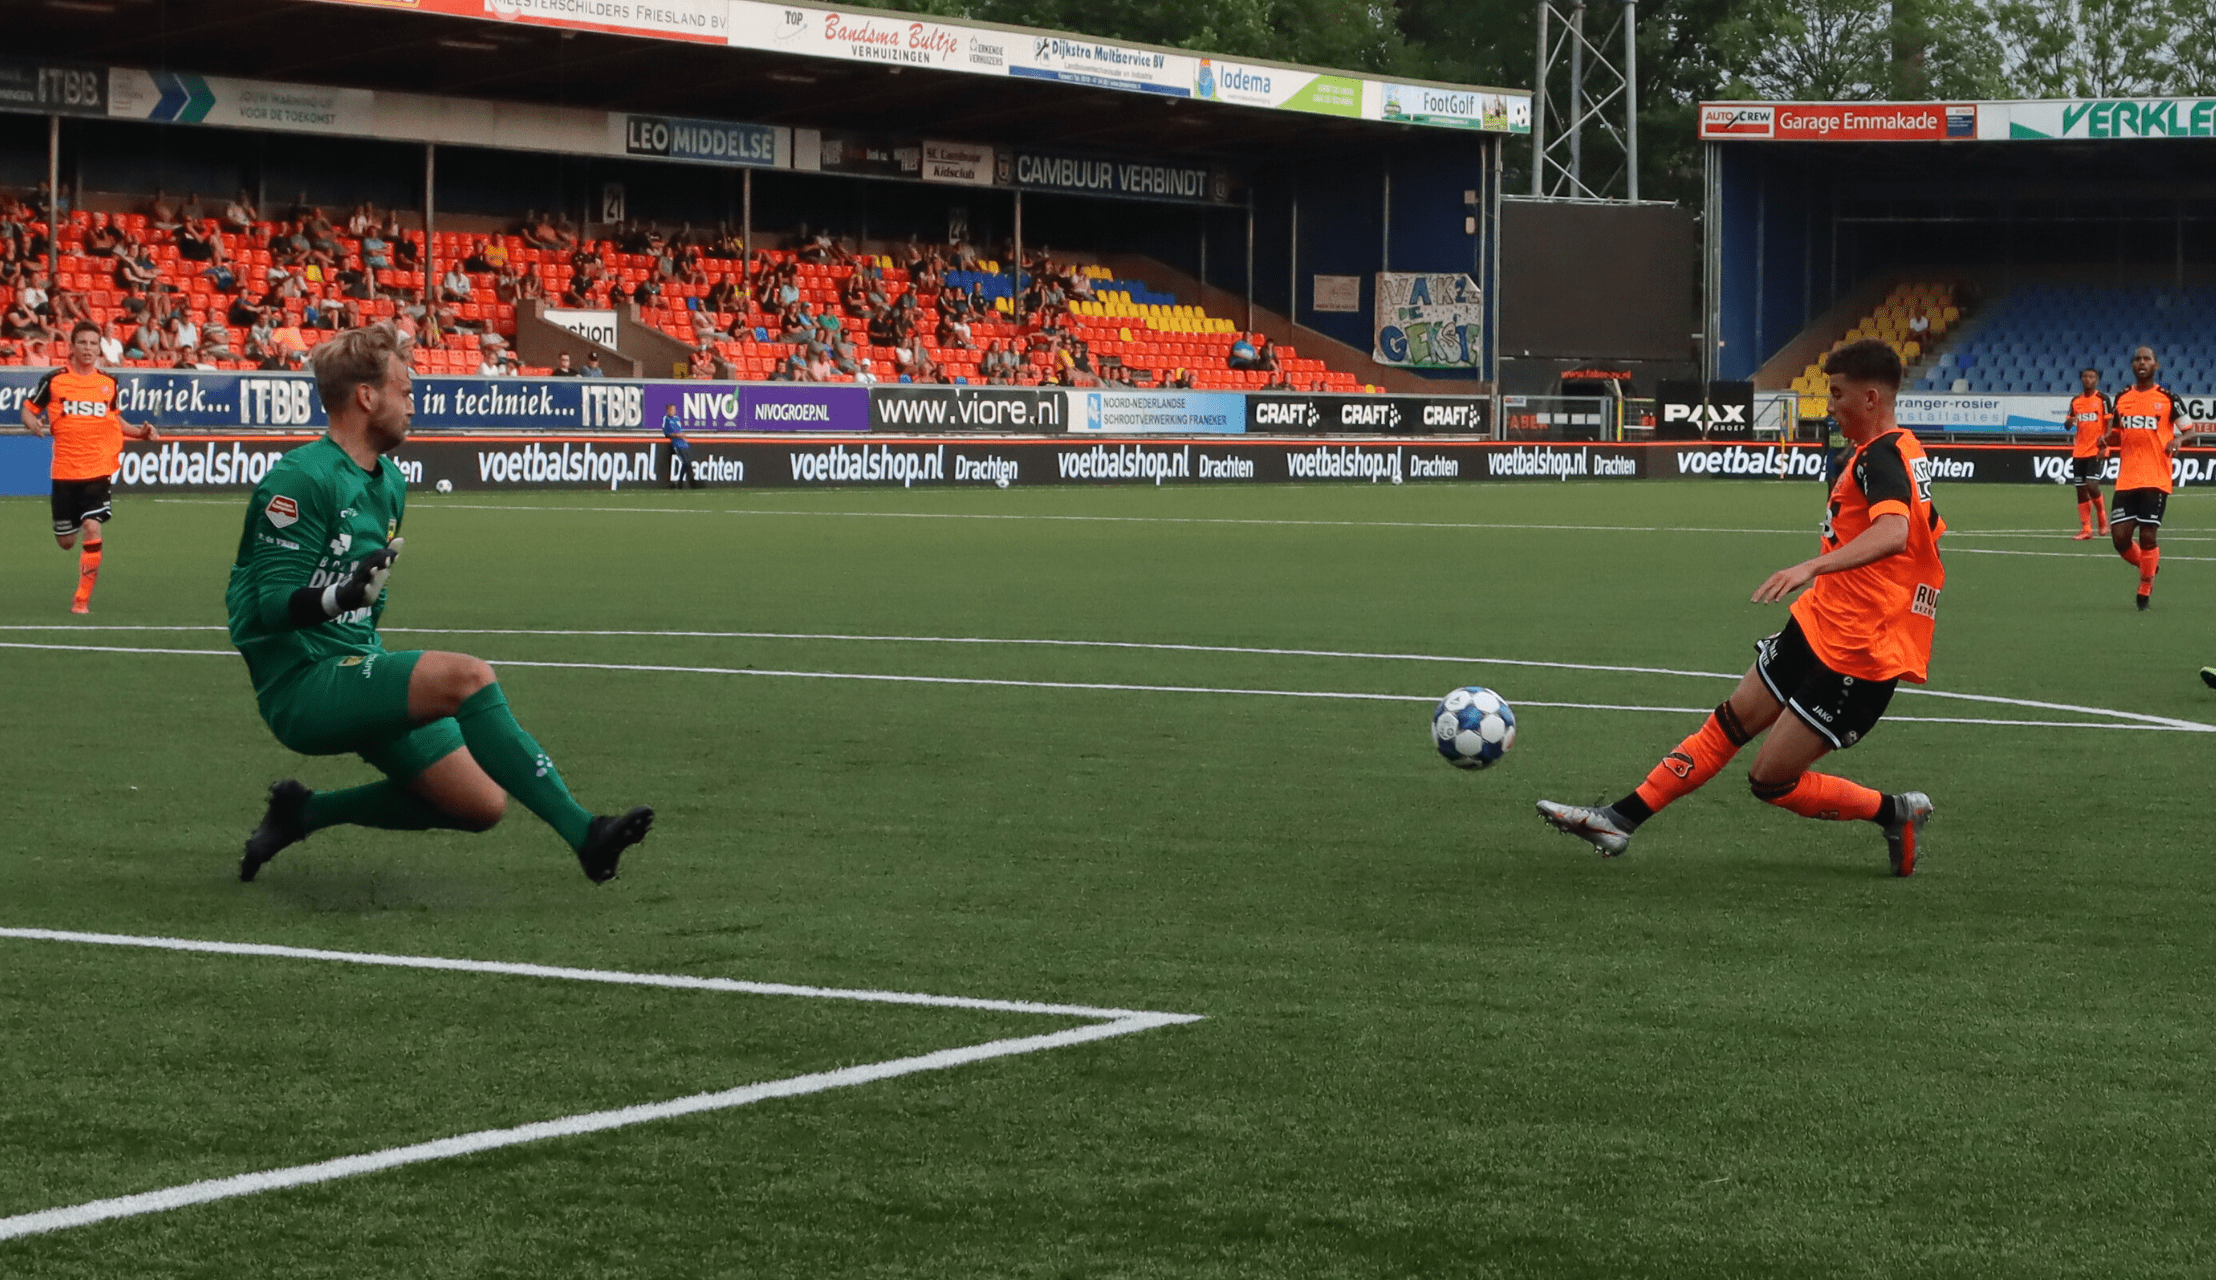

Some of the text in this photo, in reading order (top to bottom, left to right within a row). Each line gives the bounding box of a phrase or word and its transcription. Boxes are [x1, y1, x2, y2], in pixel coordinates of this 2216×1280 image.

[636, 5, 706, 27] FRIESLAND
[711, 15, 727, 29] BV
[784, 10, 804, 26] TOP
[824, 12, 958, 62] Bandsma Bultje
[851, 44, 931, 63] VERHUIZINGEN
[1052, 39, 1165, 69] Dijkstra Multiservice BV
[1423, 92, 1475, 115] FootGolf
[1706, 111, 1771, 121] AUTO CREW
[1779, 111, 1840, 134] Garage
[1843, 111, 1938, 130] Emmakade
[2063, 101, 2216, 137] VERKLE
[628, 121, 774, 160] LEO MIDDELSE
[933, 165, 975, 179] Kidsclub
[1017, 155, 1207, 197] CAMBUUR VERBINDT
[118, 377, 230, 413] chniek...
[240, 378, 312, 425] ITBB
[423, 384, 642, 427] in techniek... ITBB
[683, 392, 739, 420] NIVO
[1103, 397, 1186, 409] NOORD-NEDERLANDSE
[1895, 399, 2000, 411] ranger-rosier
[63, 400, 108, 417] HSB
[755, 403, 830, 421] NIVOGROEP.NL
[877, 391, 1060, 425] www.viore.nl
[1256, 402, 1306, 425] CRAFT
[1341, 403, 1387, 425] CRAFT
[1423, 405, 1468, 426] CRAFT
[1664, 403, 1746, 423] PAX
[1895, 410, 2000, 422] nstallaties
[2076, 412, 2098, 422] HSB
[1103, 414, 1227, 426] SCHROOTVERWERKING FRANEKER
[2120, 415, 2158, 430] HSB
[478, 441, 744, 491] voetbalshop.nl Dachten
[789, 443, 1018, 488] voetbalshop.nl Drachten
[1058, 444, 1254, 486] voetbalshop.nl Drachten
[1286, 445, 1459, 484] voetbalshop.nl Drachten
[1488, 446, 1636, 482] voetbalshop.nl Drachten
[1812, 704, 1834, 723] JAKO
